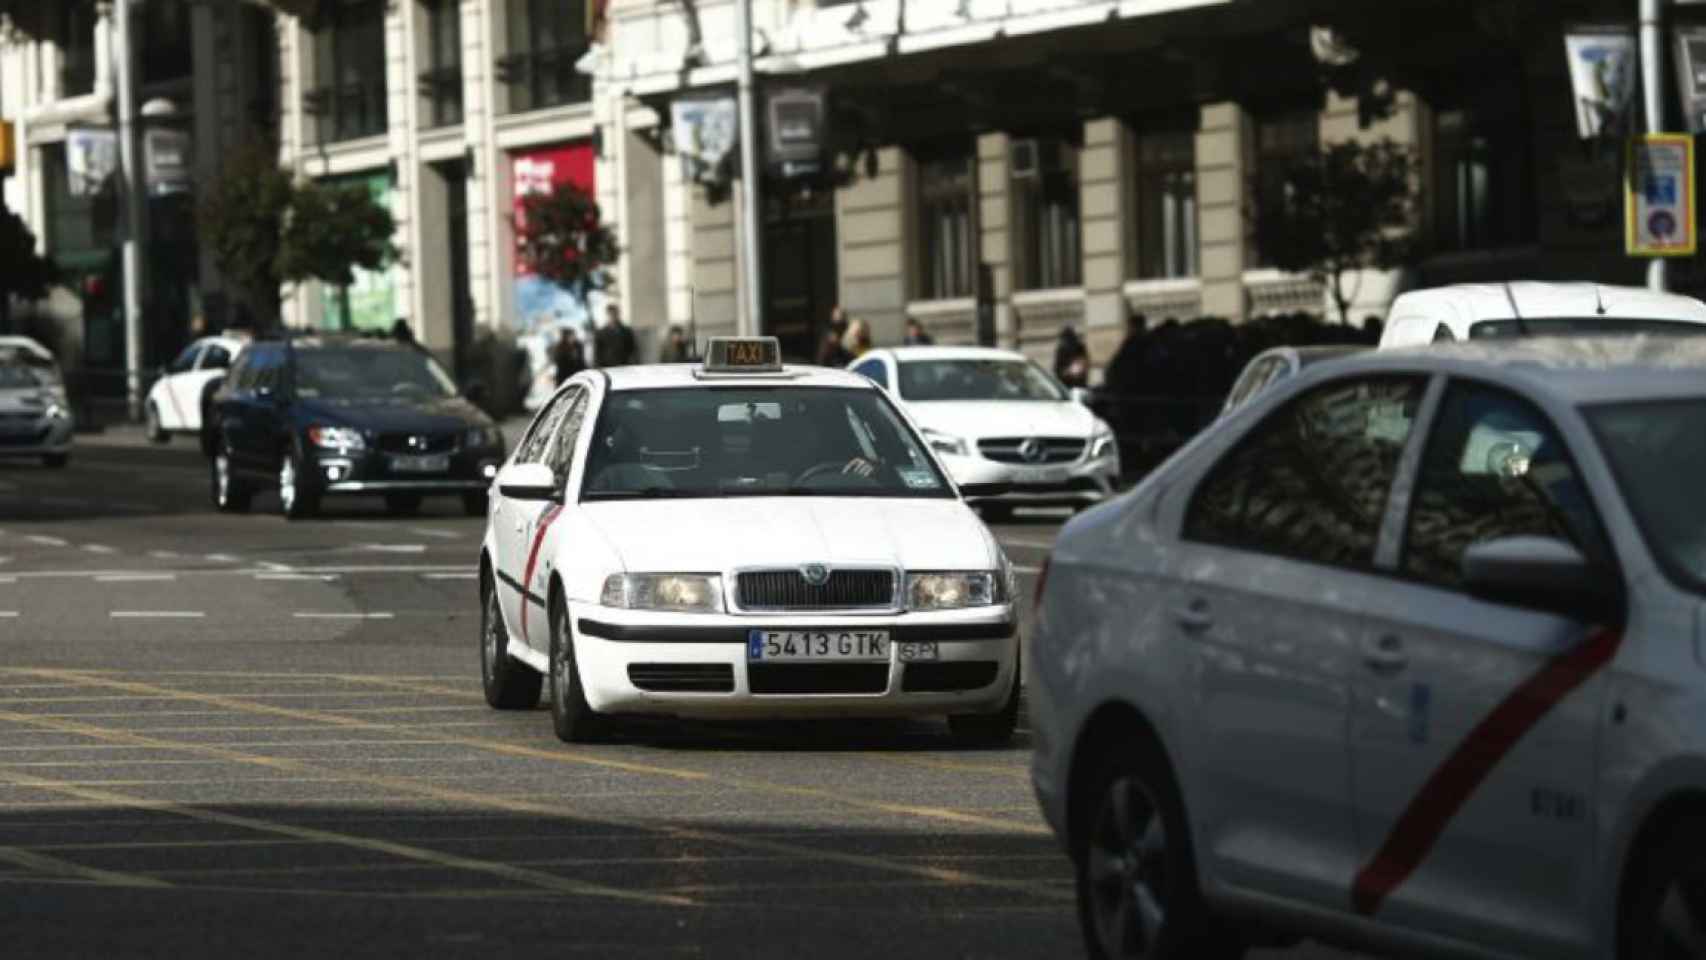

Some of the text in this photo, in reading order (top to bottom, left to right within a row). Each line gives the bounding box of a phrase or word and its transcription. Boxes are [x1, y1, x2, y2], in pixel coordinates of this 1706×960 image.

[727, 341, 764, 362] TAXI
[767, 632, 884, 657] 5413 GTK
